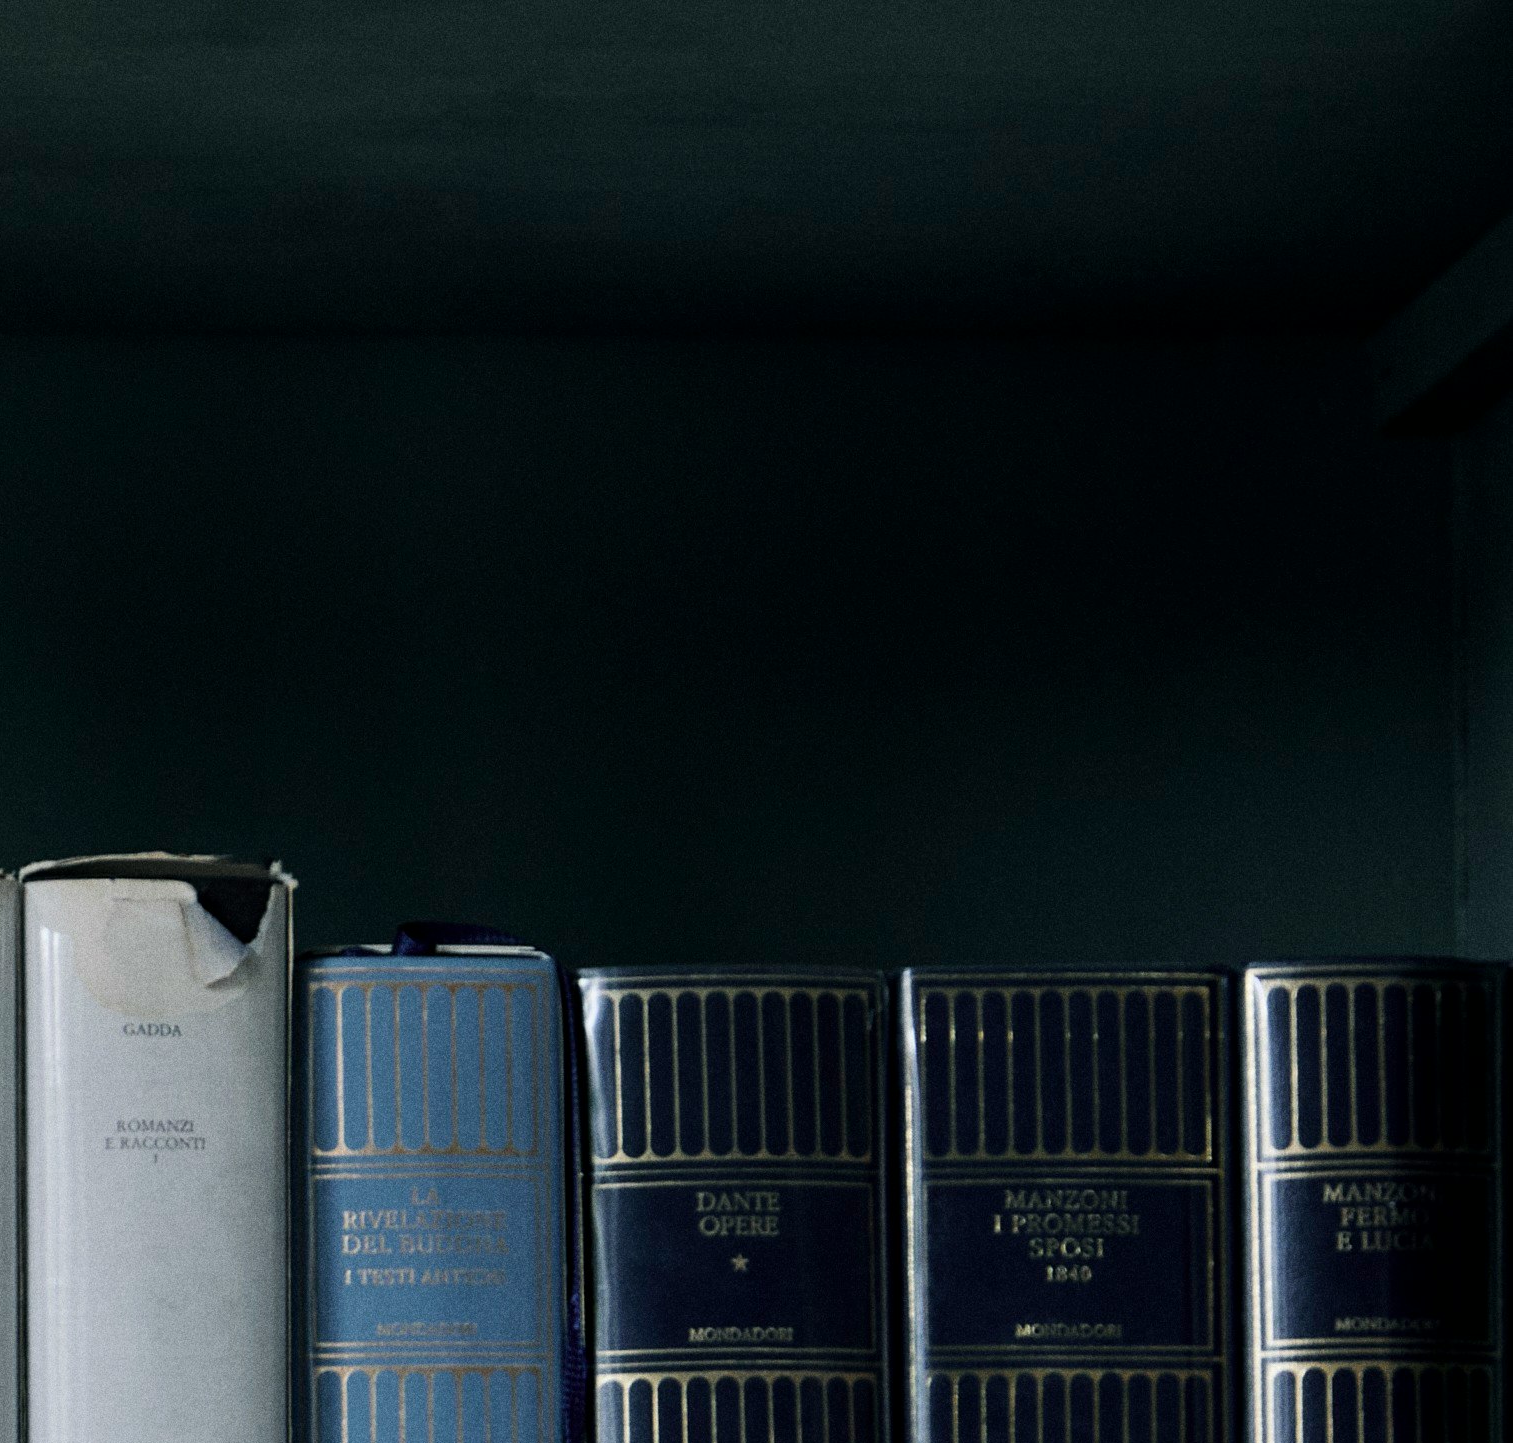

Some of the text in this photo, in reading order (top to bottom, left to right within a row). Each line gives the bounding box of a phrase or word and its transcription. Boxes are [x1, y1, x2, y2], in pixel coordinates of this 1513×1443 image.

[123, 1022, 182, 1037] GADDA
[116, 1119, 194, 1133] ROMANZI
[105, 1136, 205, 1149] E RACCONTI
[696, 1191, 781, 1212] DANTE
[1004, 1189, 1128, 1210] MANZONI
[698, 1215, 781, 1236] OPERE
[993, 1213, 1141, 1235] I PROMESSI
[341, 1234, 392, 1254] DEL
[1029, 1237, 1105, 1259] SPOSI
[1335, 1230, 1353, 1252] E
[358, 1267, 415, 1286] TESTI
[688, 1326, 794, 1342] MONDADORI
